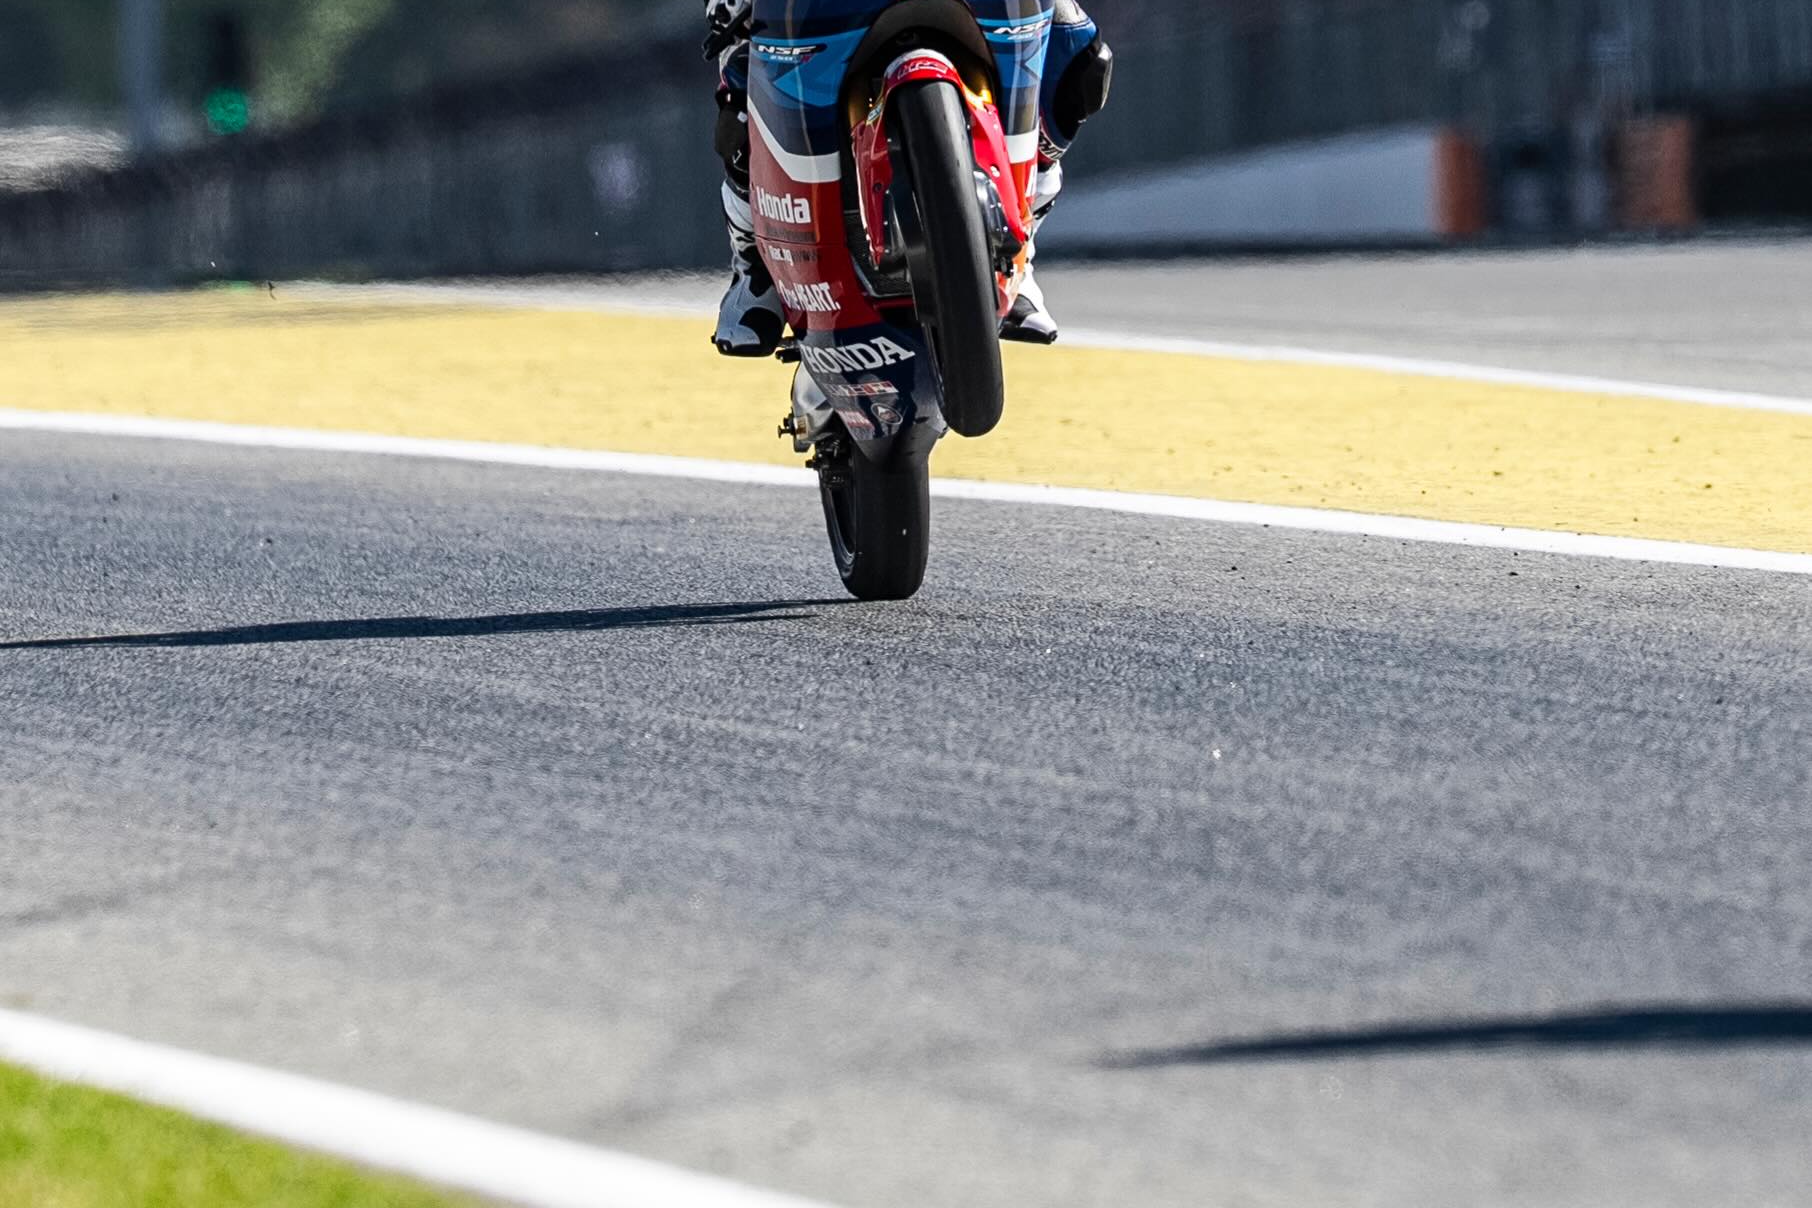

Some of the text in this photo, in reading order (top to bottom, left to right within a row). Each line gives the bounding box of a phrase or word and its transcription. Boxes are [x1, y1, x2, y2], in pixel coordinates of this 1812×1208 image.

[758, 45, 816, 55] NSF
[756, 186, 812, 224] Honda
[800, 336, 915, 373] HONDA
